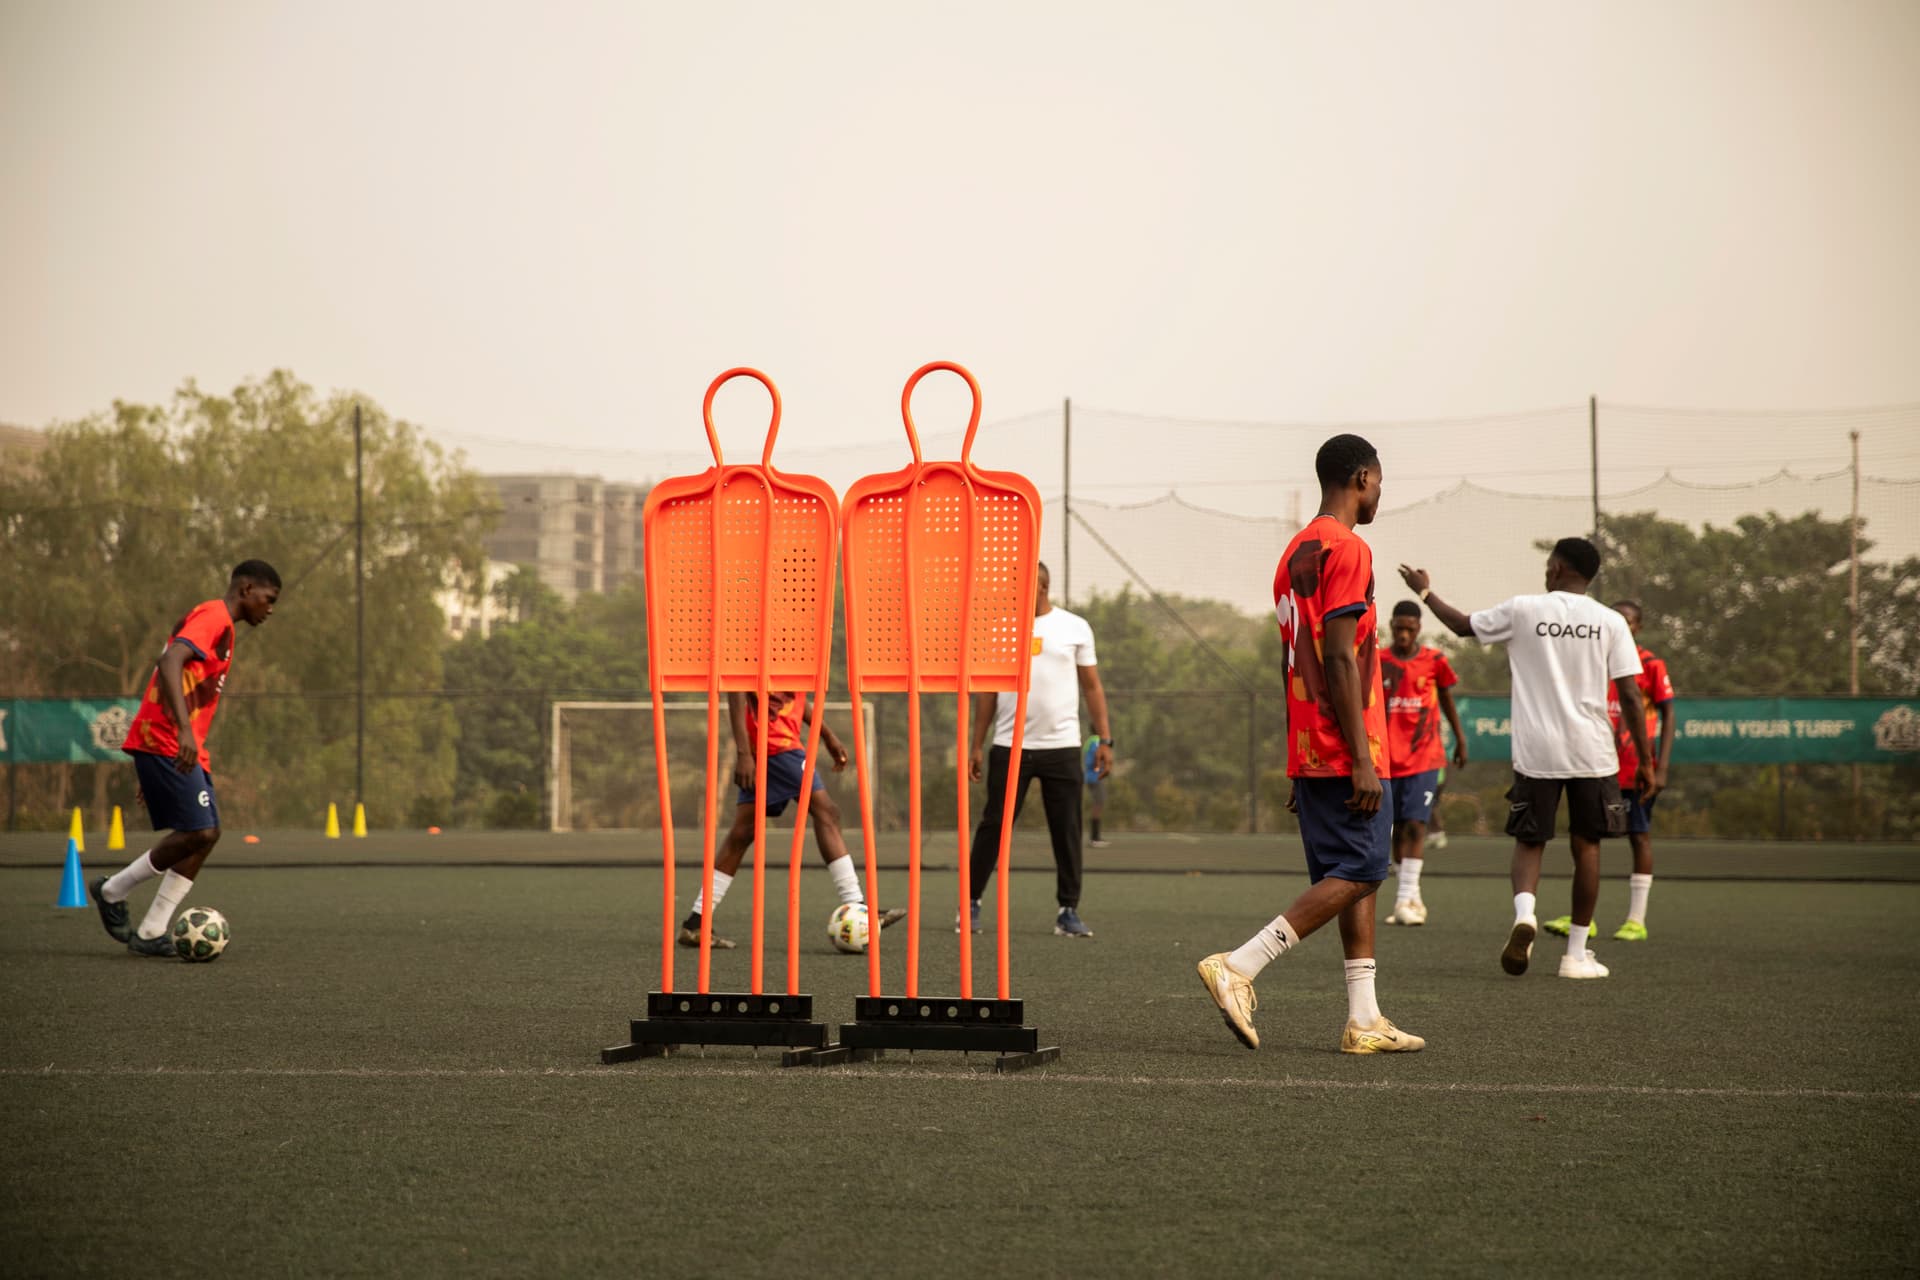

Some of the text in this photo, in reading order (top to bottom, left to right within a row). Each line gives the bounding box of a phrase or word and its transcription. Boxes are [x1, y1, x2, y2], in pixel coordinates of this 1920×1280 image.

[1536, 622, 1601, 640] COACH
[1476, 718, 1512, 736] PLA
[1684, 720, 1732, 738] OWN
[1736, 720, 1790, 738] YOUR
